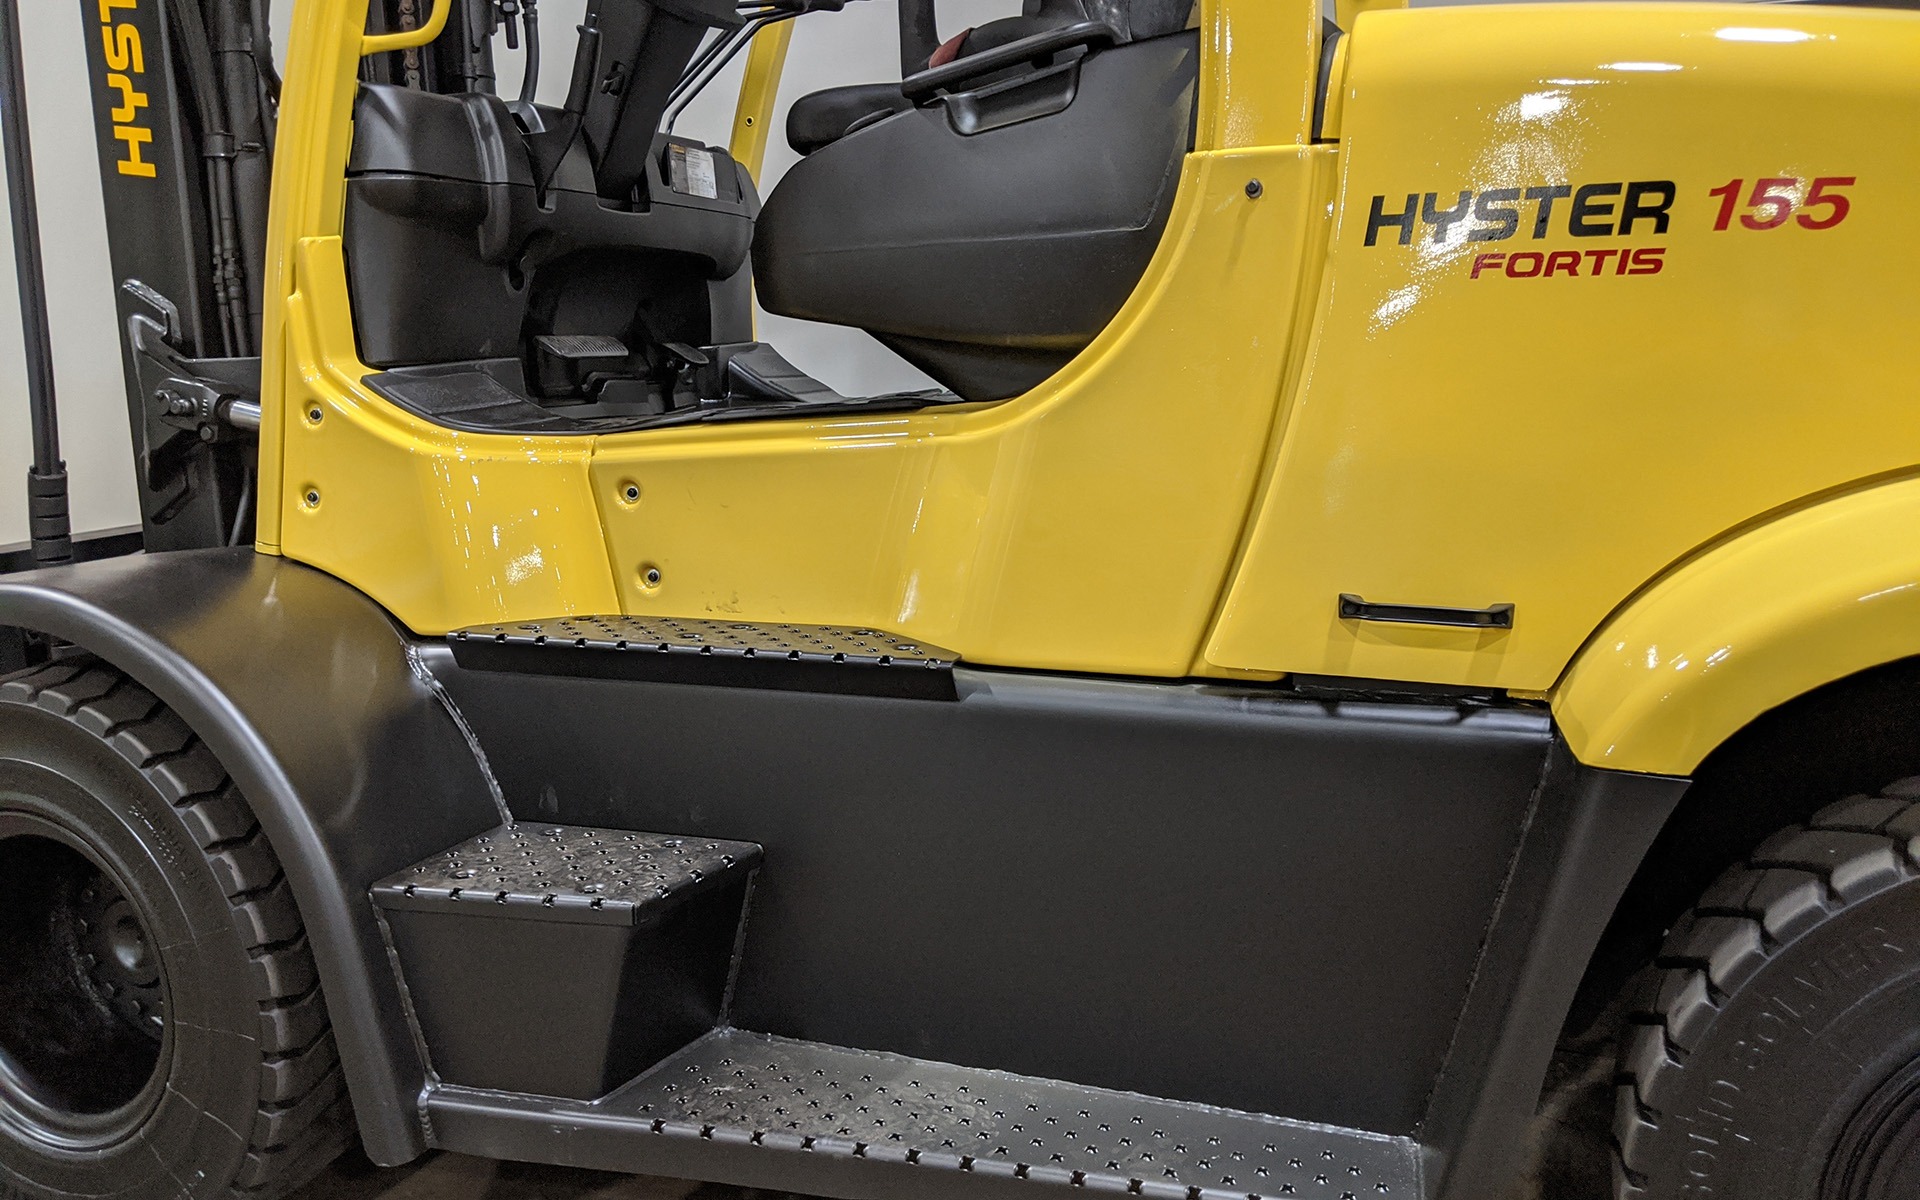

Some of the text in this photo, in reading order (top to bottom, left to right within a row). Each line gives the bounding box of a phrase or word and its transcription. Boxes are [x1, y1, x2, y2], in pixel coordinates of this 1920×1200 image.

[1364, 177, 1856, 247] HYSTER 155
[1470, 248, 1667, 279] FORTIS
